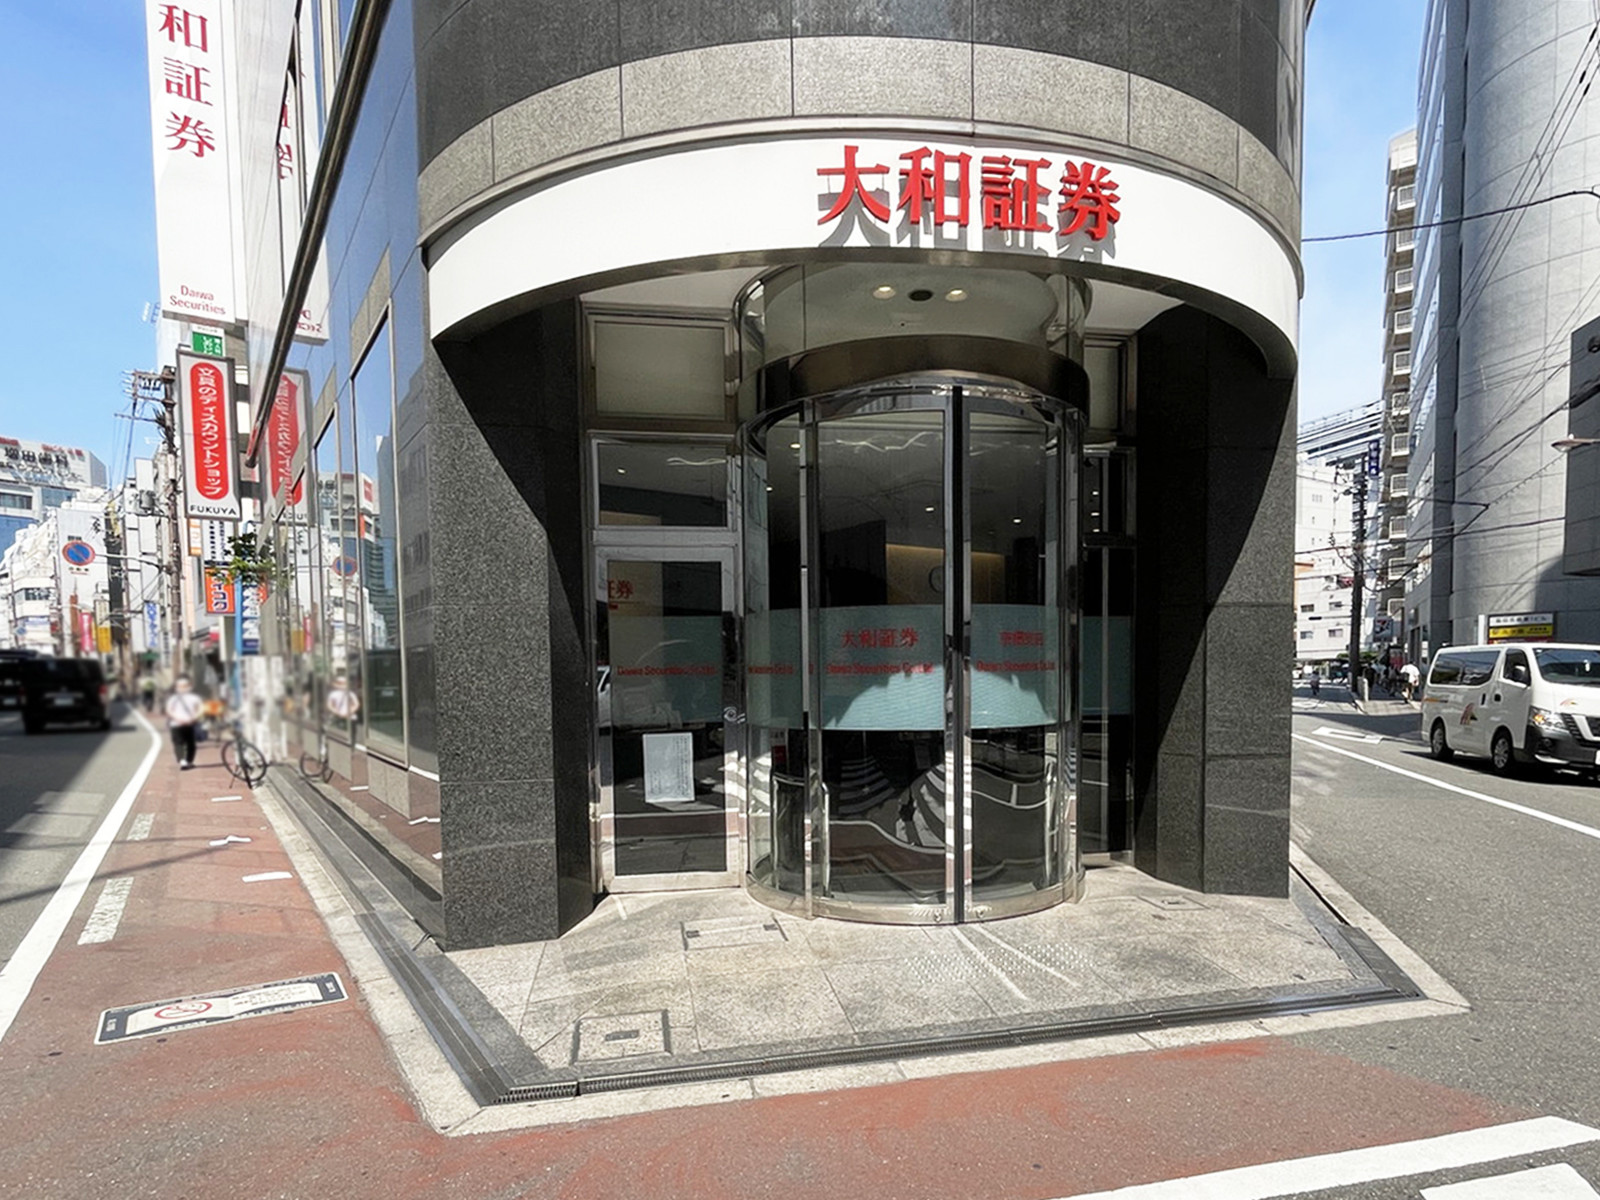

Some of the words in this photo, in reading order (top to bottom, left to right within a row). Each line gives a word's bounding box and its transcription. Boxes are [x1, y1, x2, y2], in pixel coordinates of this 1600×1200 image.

[158, 3, 216, 158] 和証券
[816, 144, 1121, 241] 大和証券
[180, 284, 215, 302] Daiwa
[169, 294, 226, 316] Securities
[189, 504, 238, 516] FUKUYA
[841, 627, 919, 649] 大和証券
